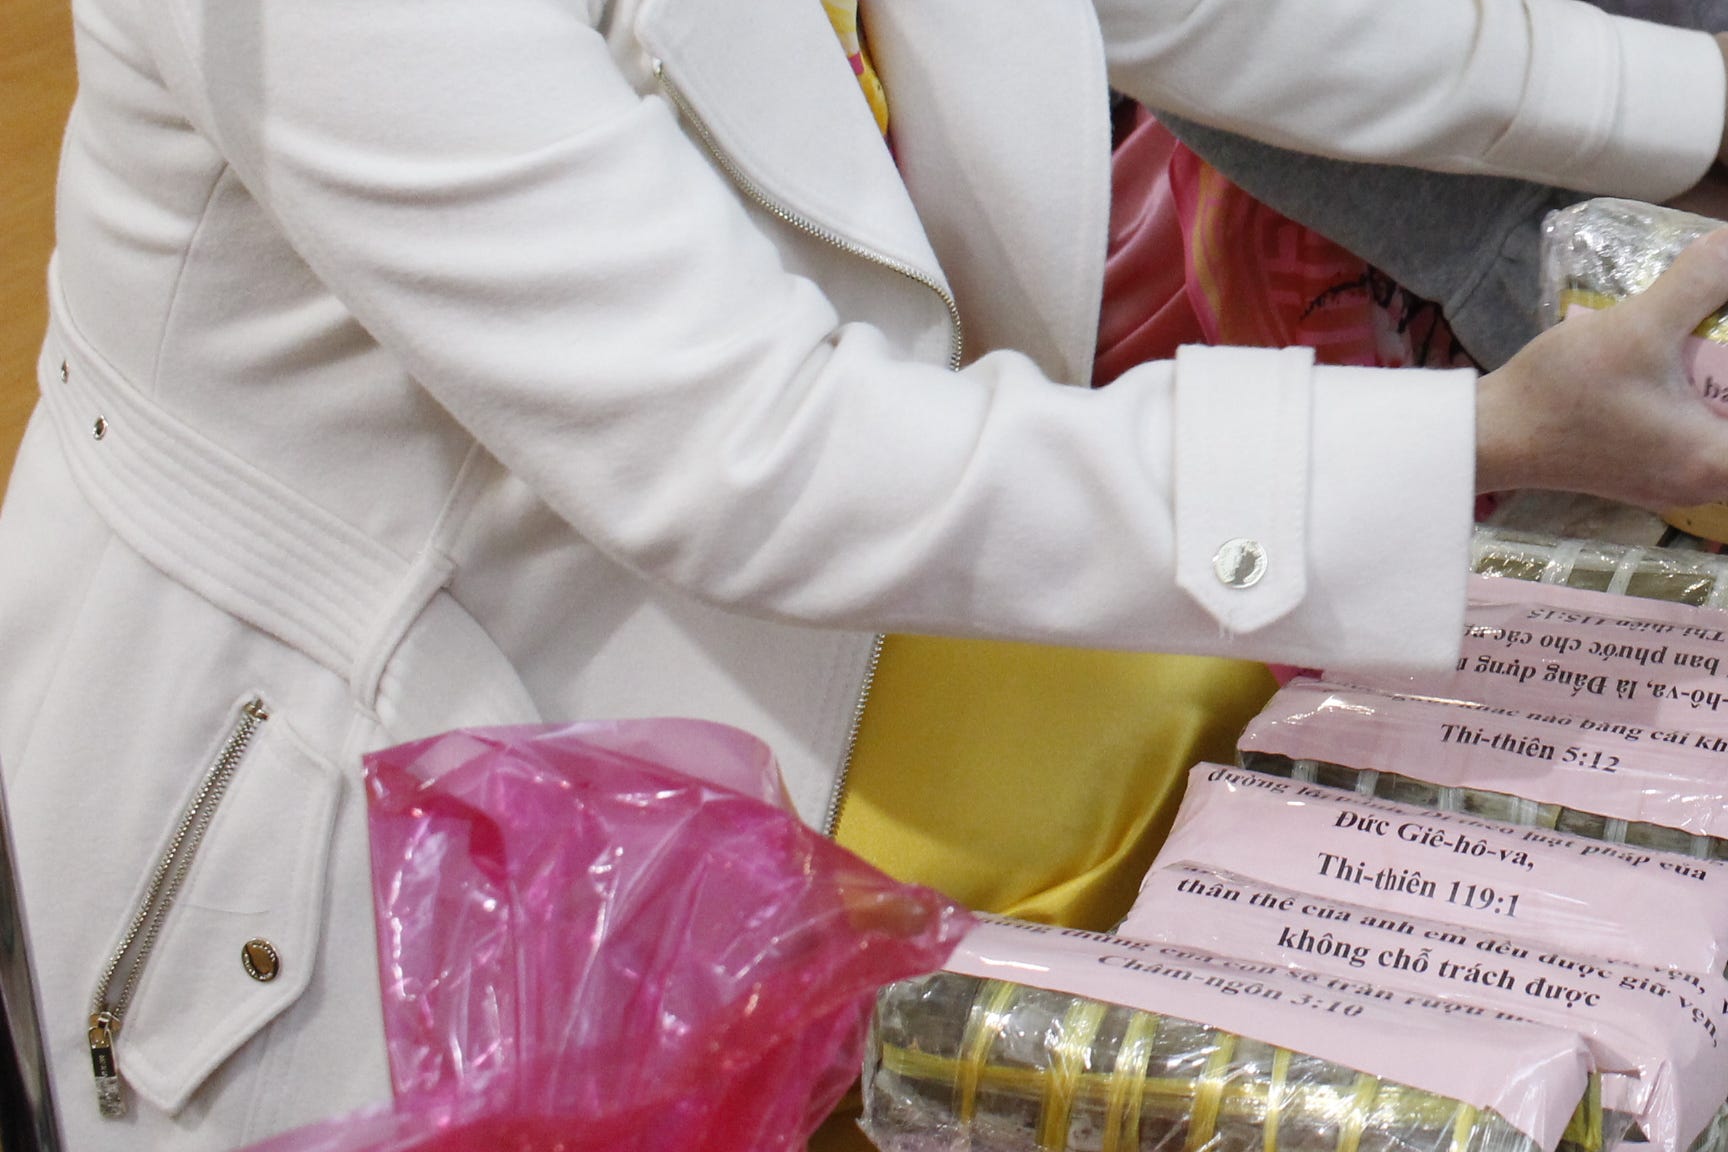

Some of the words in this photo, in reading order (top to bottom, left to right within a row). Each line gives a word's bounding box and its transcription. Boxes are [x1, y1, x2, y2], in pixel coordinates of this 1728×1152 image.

[1527, 608, 1608, 626] 115:15
[1494, 628, 1532, 648] các
[1541, 634, 1582, 655] cho
[1588, 638, 1668, 666] phước
[1474, 655, 1537, 683] dựng
[1674, 652, 1720, 677] ban
[1544, 664, 1608, 697] Đấng
[1617, 679, 1638, 700] là
[1440, 723, 1555, 761] Thi-thiên
[1561, 745, 1621, 773] 5:12
[1649, 728, 1690, 745] cái
[1207, 767, 1291, 794] đường
[1333, 810, 1390, 837] Đức
[1397, 822, 1535, 872] Giê-hô-va,
[1318, 851, 1437, 899] Thi-thiên
[1447, 880, 1520, 918] 119:1
[1177, 878, 1241, 901] thân
[1359, 914, 1415, 934] anh
[1424, 930, 1466, 945] em
[1538, 953, 1613, 978] được
[1619, 976, 1671, 997] giữ
[1679, 995, 1718, 1047] vẹn,
[1277, 927, 1371, 969] không
[1378, 948, 1433, 974] chỗ
[1438, 958, 1516, 990] trách
[1525, 976, 1601, 1008] được
[1099, 954, 1283, 1001] Châm-ngôn
[1290, 994, 1364, 1018] 3:10
